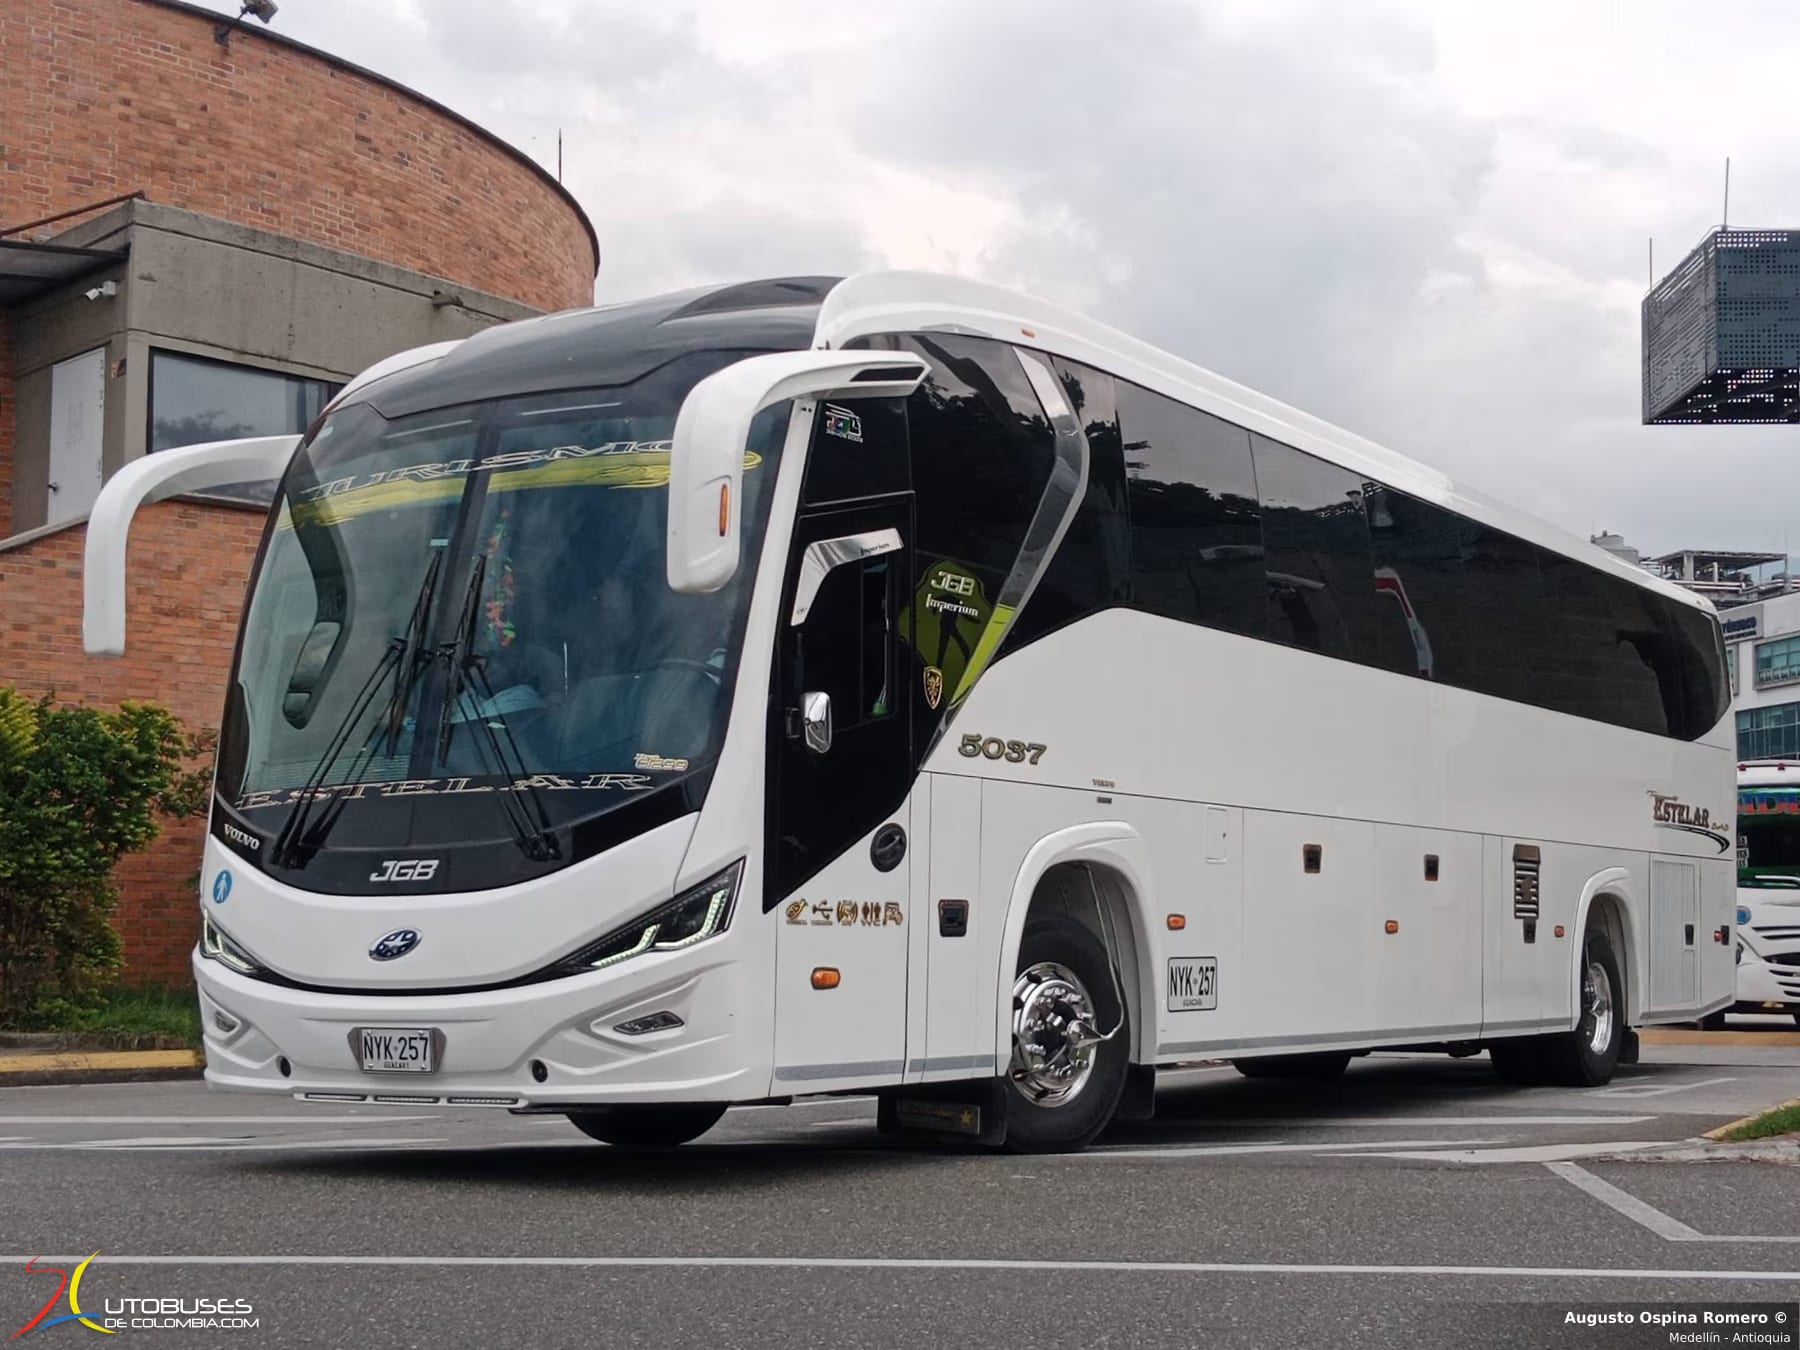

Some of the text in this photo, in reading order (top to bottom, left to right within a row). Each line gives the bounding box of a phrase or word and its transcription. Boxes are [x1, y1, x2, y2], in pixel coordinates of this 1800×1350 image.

[931, 570, 976, 597] JGB
[925, 592, 979, 617] Imperium
[957, 733, 1048, 766] 5037
[236, 773, 656, 811] ESTELAR
[223, 823, 261, 850] VOLVO
[369, 859, 440, 882] JGB
